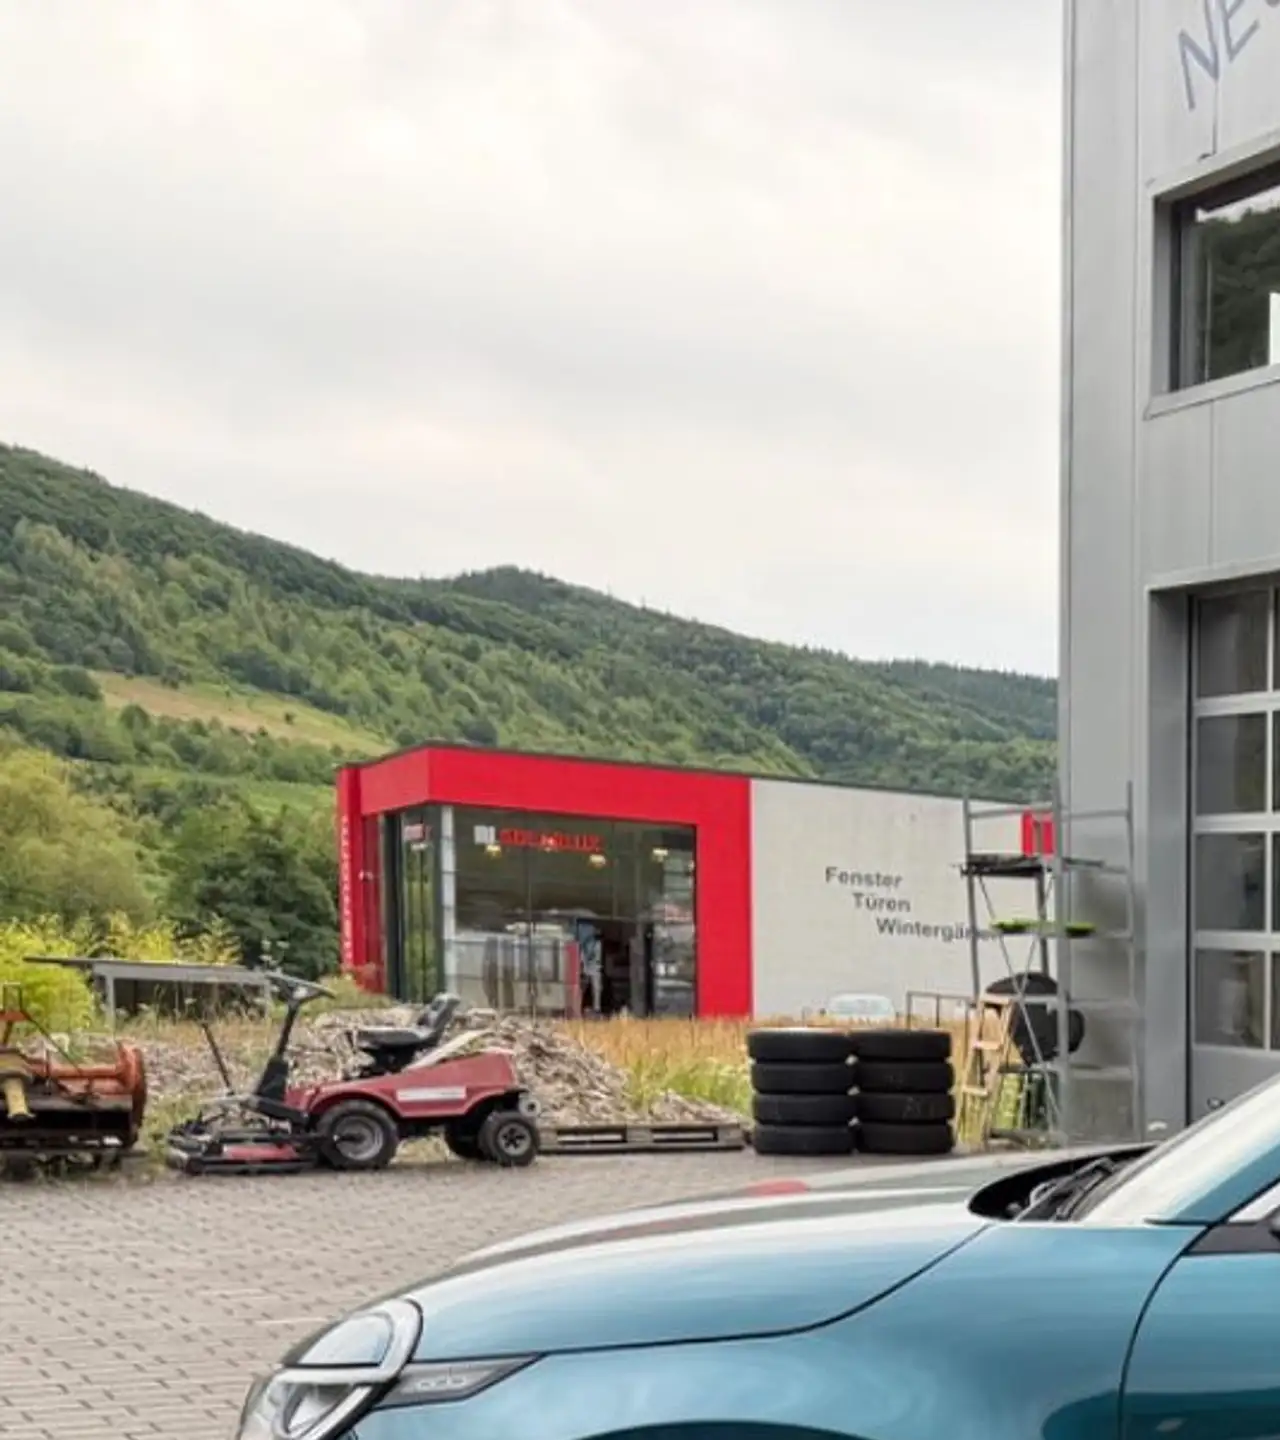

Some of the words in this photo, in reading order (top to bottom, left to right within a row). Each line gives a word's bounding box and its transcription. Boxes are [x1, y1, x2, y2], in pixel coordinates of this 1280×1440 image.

[824, 865, 904, 889] Fenster
[852, 891, 912, 914] Türen
[876, 916, 998, 943] Wintergär
